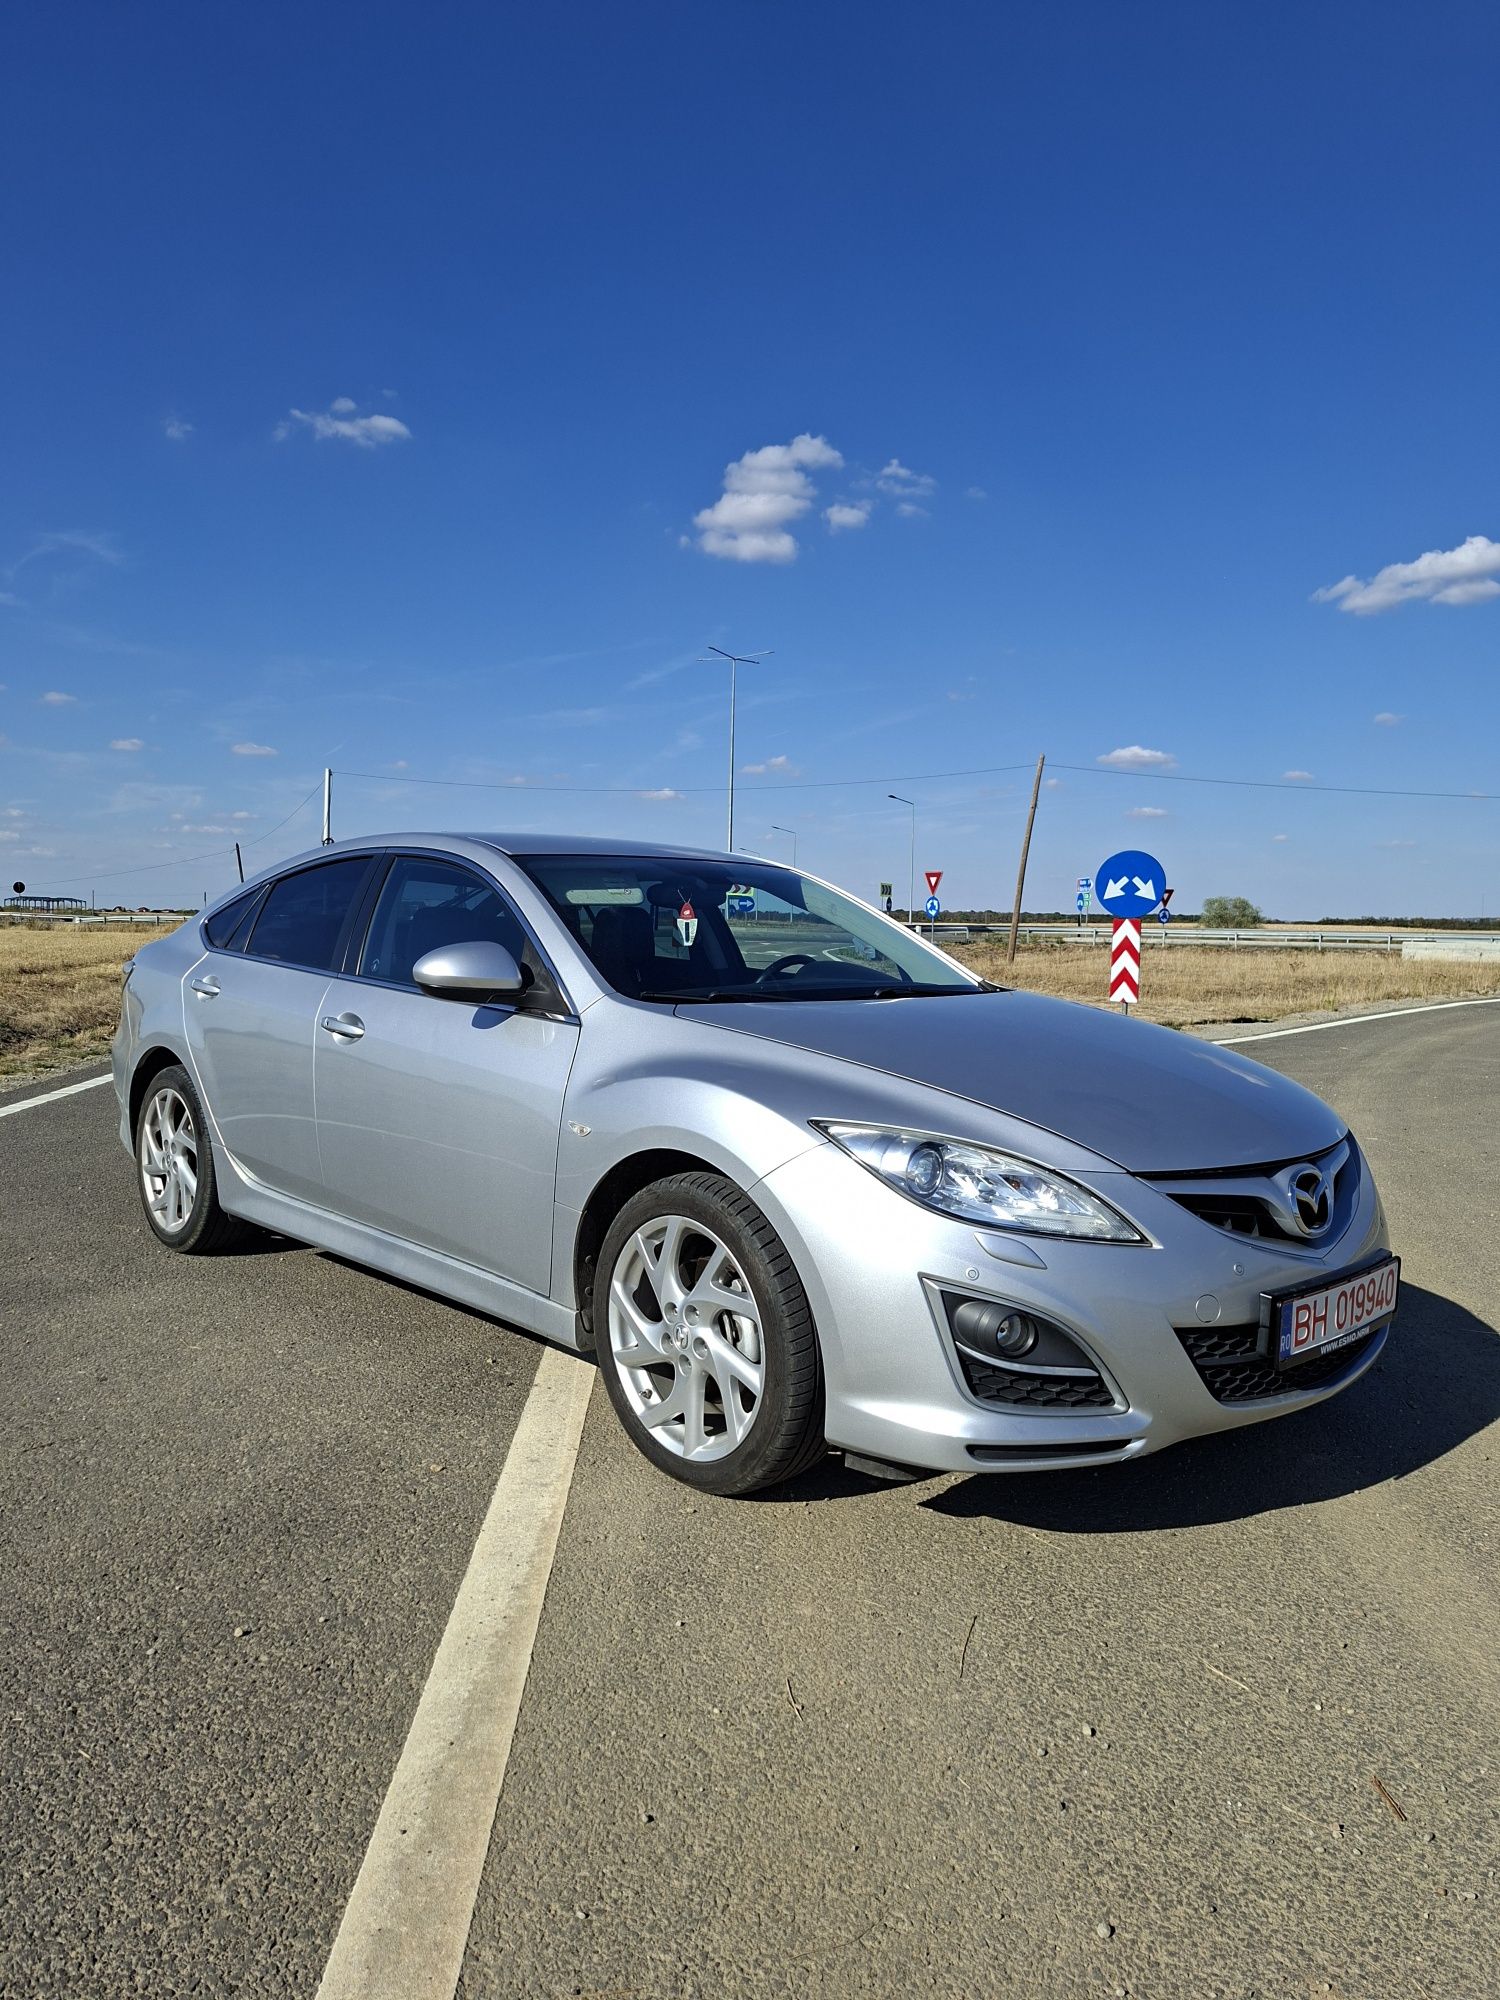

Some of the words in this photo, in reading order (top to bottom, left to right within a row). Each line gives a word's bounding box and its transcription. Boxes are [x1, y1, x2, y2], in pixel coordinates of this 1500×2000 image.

[1294, 1296, 1329, 1347] BH
[1336, 1268, 1395, 1329] 019940
[1280, 1334, 1291, 1352] RO
